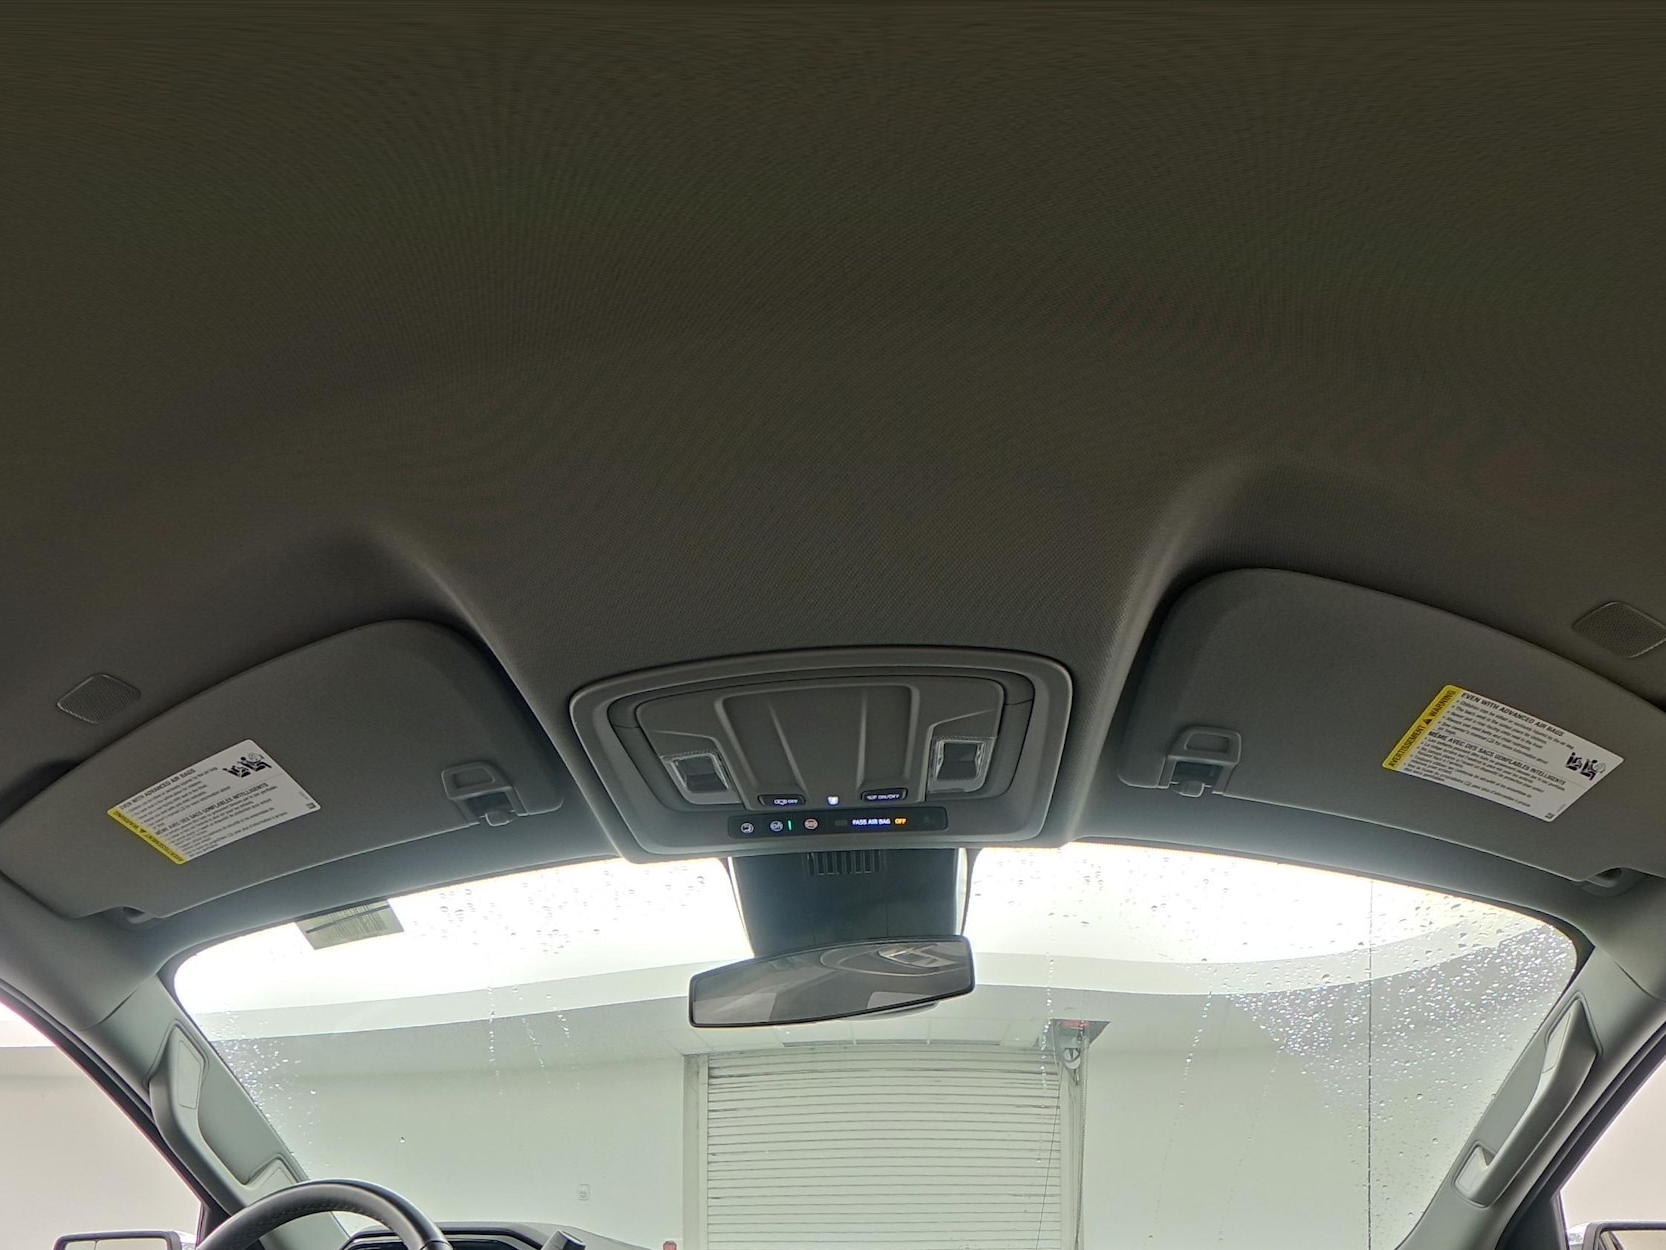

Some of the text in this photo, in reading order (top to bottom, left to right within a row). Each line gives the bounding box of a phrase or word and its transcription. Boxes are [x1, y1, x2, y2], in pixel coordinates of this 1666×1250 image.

[1429, 690, 1456, 717] WARNING
[1461, 692, 1480, 703] EVEN
[1481, 697, 1499, 710] WITH
[1499, 707, 1535, 724] ADVANCED
[1534, 721, 1546, 729] AIR
[895, 817, 907, 825] OFF
